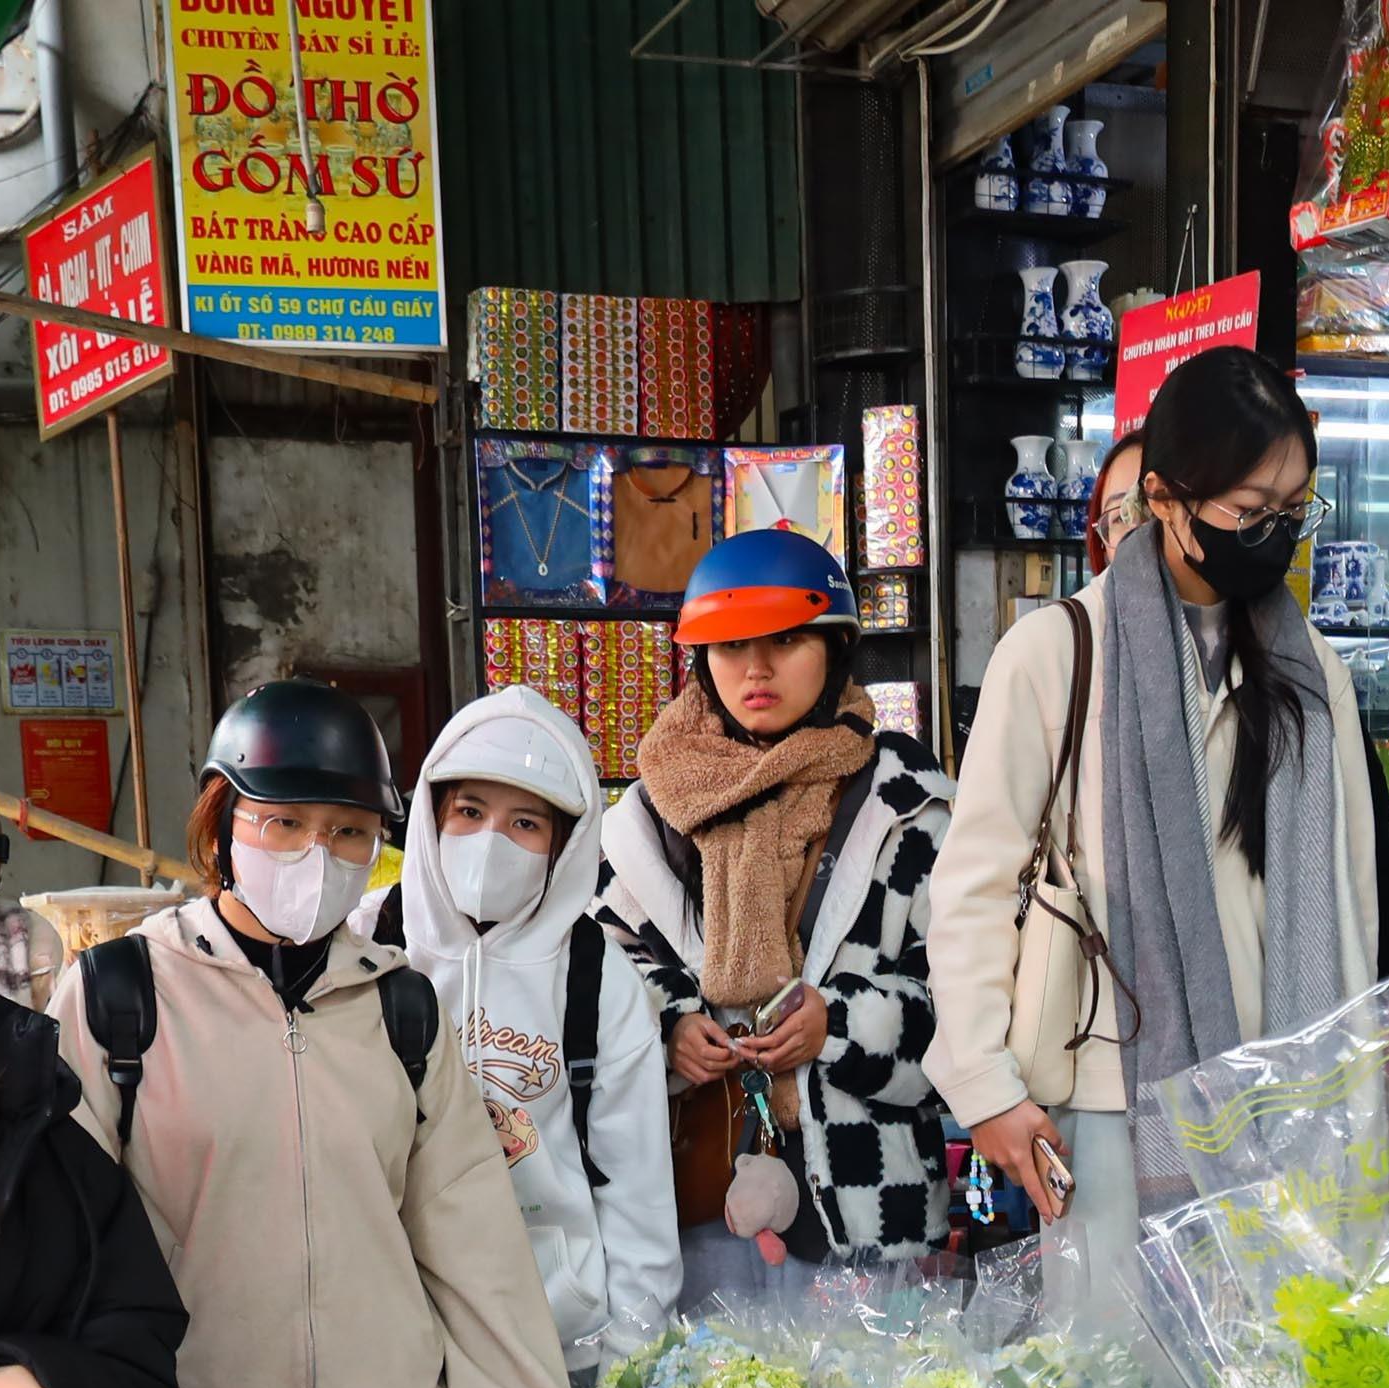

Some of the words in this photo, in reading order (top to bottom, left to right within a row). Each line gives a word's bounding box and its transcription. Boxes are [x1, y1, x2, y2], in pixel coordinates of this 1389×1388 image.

[181, 26, 279, 51] CHUYÊN
[289, 29, 340, 54] BÁN
[186, 59, 277, 118] ĐỒ
[290, 71, 420, 124] THỜ
[192, 134, 338, 196] GỐM
[351, 146, 425, 199] SỨ
[62, 195, 114, 243] SÂM
[191, 211, 239, 240] BÁT
[334, 221, 382, 244] CAO
[388, 212, 435, 246] CẤP
[120, 211, 153, 277] CHIM
[195, 251, 254, 275] VÀNG
[260, 253, 301, 279] MÃ,
[308, 255, 380, 279] HƯƠNG
[387, 254, 430, 280] NẾN
[194, 295, 214, 313] KI
[219, 290, 242, 313] ỐT
[248, 291, 274, 314] SỐ
[279, 298, 301, 315] 59
[307, 298, 345, 319] CHỢ
[350, 294, 387, 317] CẦU
[392, 296, 434, 318] GIẤY
[45, 331, 80, 380] XÔI
[238, 322, 267, 340] ĐT:
[272, 324, 318, 342] 0989
[323, 326, 356, 342] 314
[362, 326, 396, 343] 248
[1123, 338, 1154, 362] CHUYÊN
[1195, 322, 1216, 342] THEO
[1217, 315, 1233, 336] YÊU
[49, 387, 70, 414] ĐT:
[70, 367, 103, 401] 0985
[104, 351, 131, 382] 815
